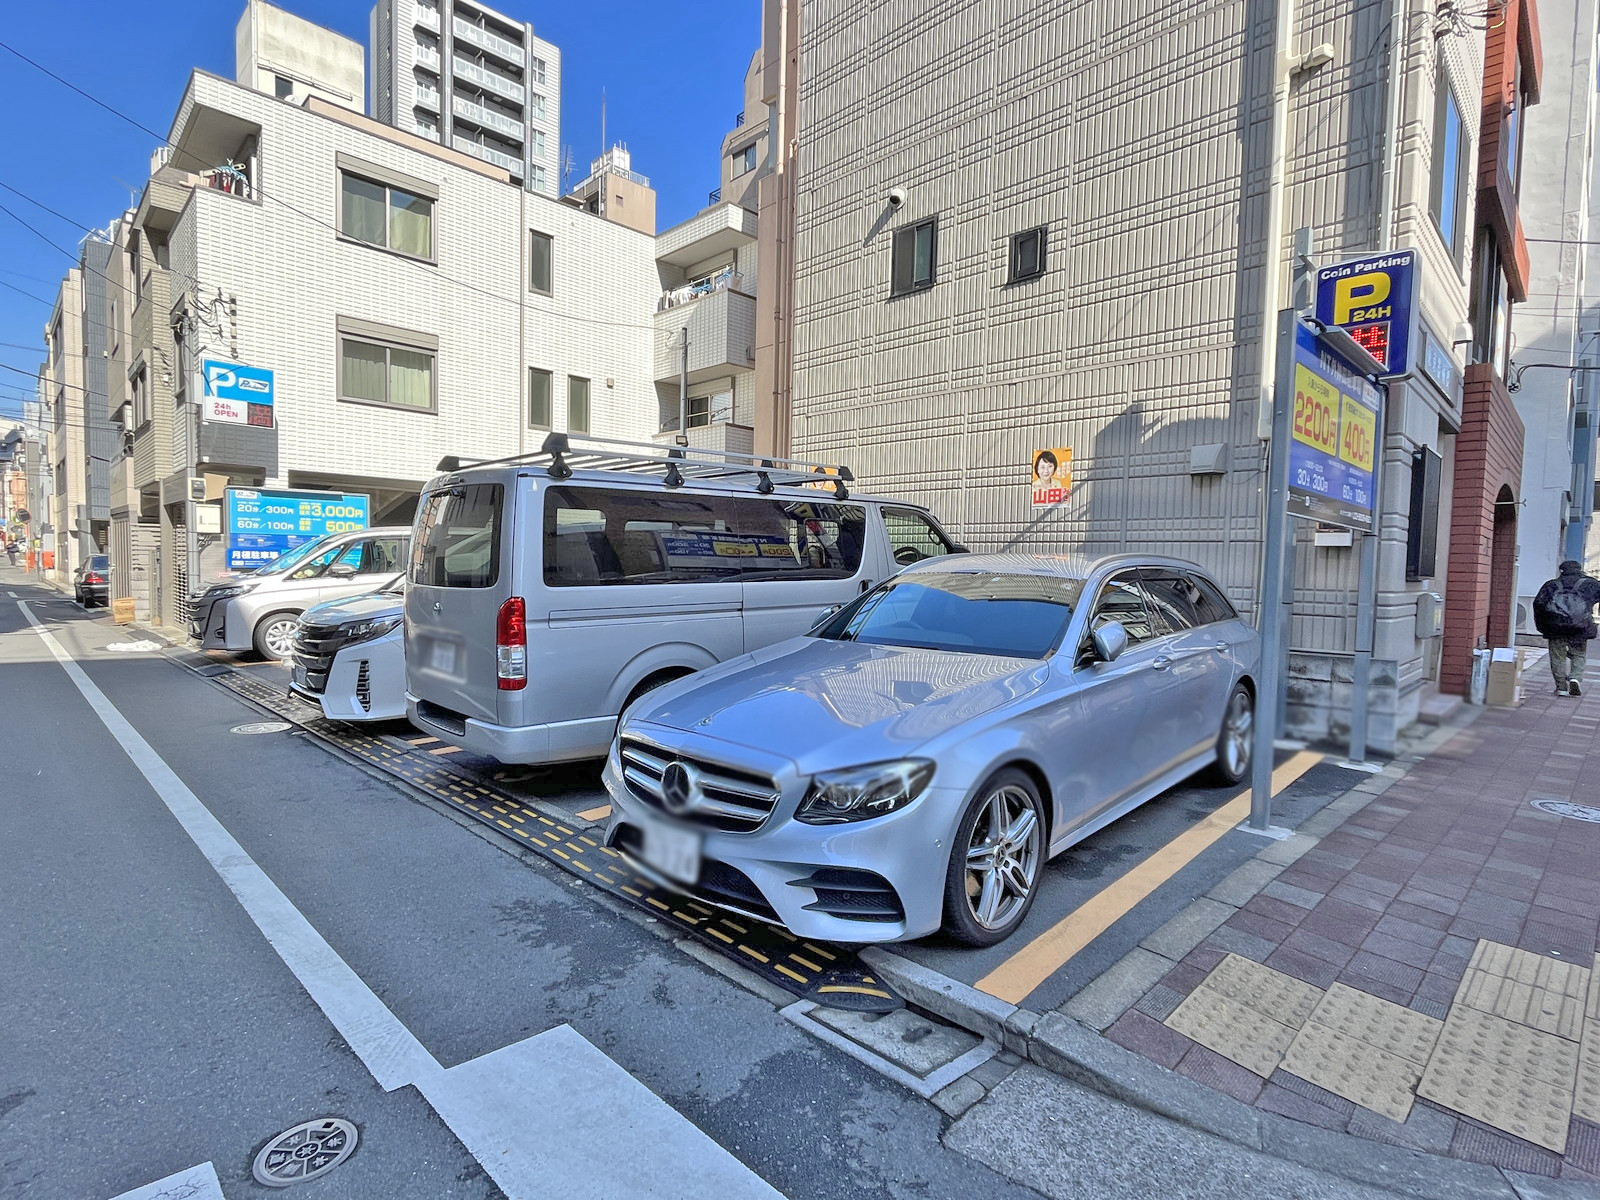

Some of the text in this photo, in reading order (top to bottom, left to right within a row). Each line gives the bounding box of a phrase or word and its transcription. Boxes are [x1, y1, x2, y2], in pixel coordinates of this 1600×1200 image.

[1320, 255, 1411, 281] Coin Parking
[1333, 272, 1392, 326] P
[1352, 306, 1392, 323] 24H
[209, 366, 236, 398] P
[213, 409, 239, 418] OPEN
[214, 402, 231, 410] 24h
[1294, 391, 1337, 450] 2200円
[1344, 421, 1371, 465] 400円
[1297, 468, 1310, 487] 30分
[1312, 473, 1328, 493] 300円
[1033, 488, 1062, 504] 山田
[325, 521, 364, 533] 500円
